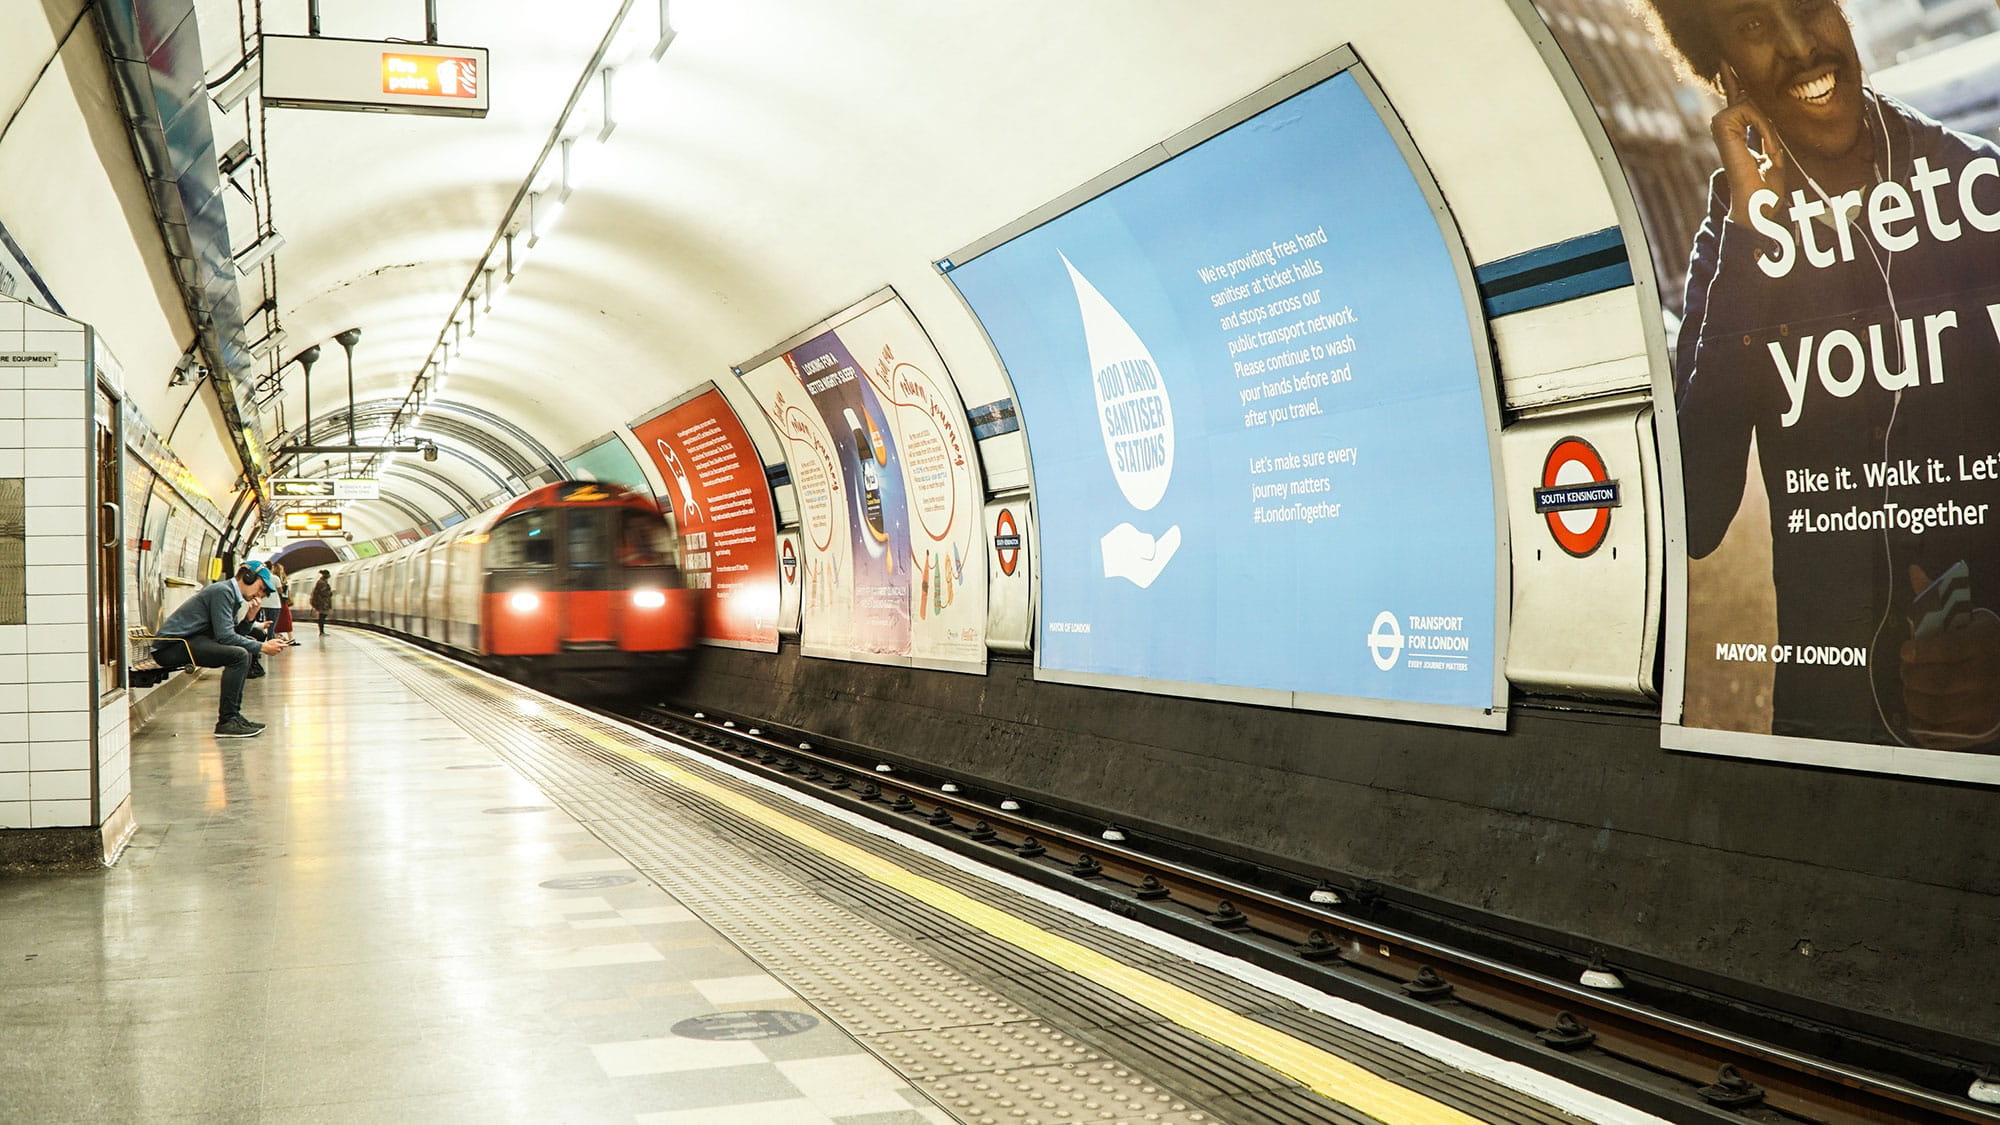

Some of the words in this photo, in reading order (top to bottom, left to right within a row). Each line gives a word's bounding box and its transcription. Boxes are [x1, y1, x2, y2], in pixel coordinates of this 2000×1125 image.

[1197, 264, 1228, 284] We're
[1227, 249, 1277, 279] providing
[1272, 240, 1298, 258] free
[1296, 224, 1328, 250] hand
[1210, 283, 1252, 308] sanitiser
[1251, 278, 1264, 294] at
[1262, 267, 1296, 290] ticket
[1293, 258, 1324, 280] halls
[1220, 311, 1240, 330] and
[1239, 306, 1268, 325] stops
[1267, 295, 1302, 317] across
[1302, 289, 1321, 306] our
[1228, 334, 1258, 358] public
[1258, 322, 1308, 344] transport
[1307, 305, 1358, 334] network.
[1234, 360, 1266, 378] Please
[1266, 348, 1310, 370] continue
[1311, 345, 1324, 360] to
[1325, 334, 1356, 357] wash
[1767, 310, 1958, 428] your
[1098, 363, 1124, 402] 1000
[1120, 360, 1158, 394] HAND
[1240, 386, 1261, 407] your
[1262, 377, 1292, 399] hands
[1293, 371, 1329, 392] before
[1330, 362, 1352, 384] and
[1105, 396, 1166, 437] SANITISER
[1244, 409, 1268, 428] after
[1269, 406, 1288, 426] you
[1289, 396, 1323, 418] travel.
[1115, 433, 1166, 472] STATIONS
[1250, 456, 1272, 474] Let's
[1274, 452, 1300, 470] make
[1302, 451, 1326, 468] sure
[1328, 448, 1357, 466] every
[1252, 482, 1288, 502] journey
[1290, 478, 1330, 495] matters
[1786, 468, 1830, 494] Bike
[1835, 466, 1858, 490] it.
[1863, 460, 1920, 488] Walk
[1927, 458, 1952, 484] it.
[1254, 501, 1341, 524] #LondonTogether
[1541, 493, 1566, 504] SOUTH
[1567, 488, 1614, 502] KENSINGTON
[1788, 500, 1989, 534] #LondonTogether
[1409, 616, 1464, 631] TRANSPORT
[1408, 635, 1426, 650] FOR
[1428, 636, 1469, 651] LONDON
[1716, 643, 1767, 662] MAYOR
[1770, 644, 1792, 663] OF
[1796, 646, 1866, 666] LONDON
